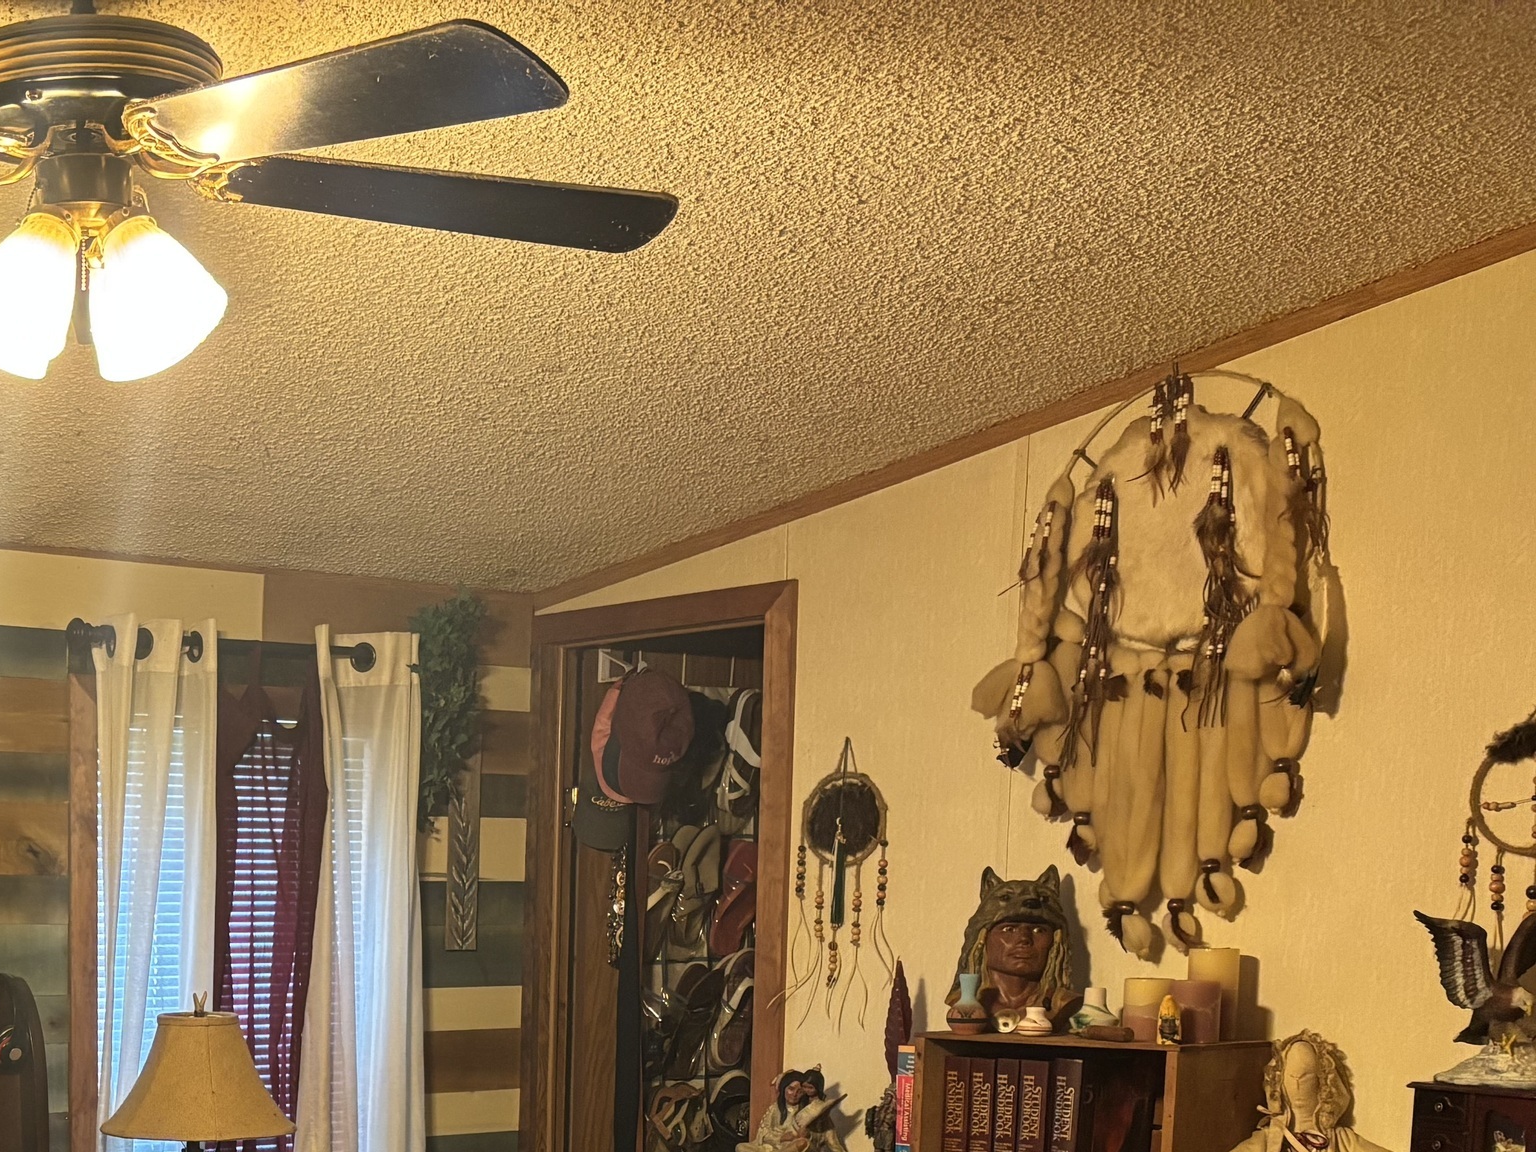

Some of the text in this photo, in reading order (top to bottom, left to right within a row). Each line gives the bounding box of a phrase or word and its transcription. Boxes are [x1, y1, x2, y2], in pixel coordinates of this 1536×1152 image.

[946, 1071, 958, 1134] HANDBOOK
[955, 1081, 965, 1132] STUDENT
[971, 1072, 983, 1136] HANDBOOK
[979, 1083, 990, 1135] STUDENT
[995, 1074, 1008, 1139] HANDBOOK
[1004, 1085, 1015, 1137] STUDENT
[1019, 1075, 1034, 1141] HANDBOOK
[1030, 1086, 1042, 1139] STUDENT
[1053, 1076, 1066, 1142] HANDBOOK
[1063, 1087, 1074, 1141] STUDENT
